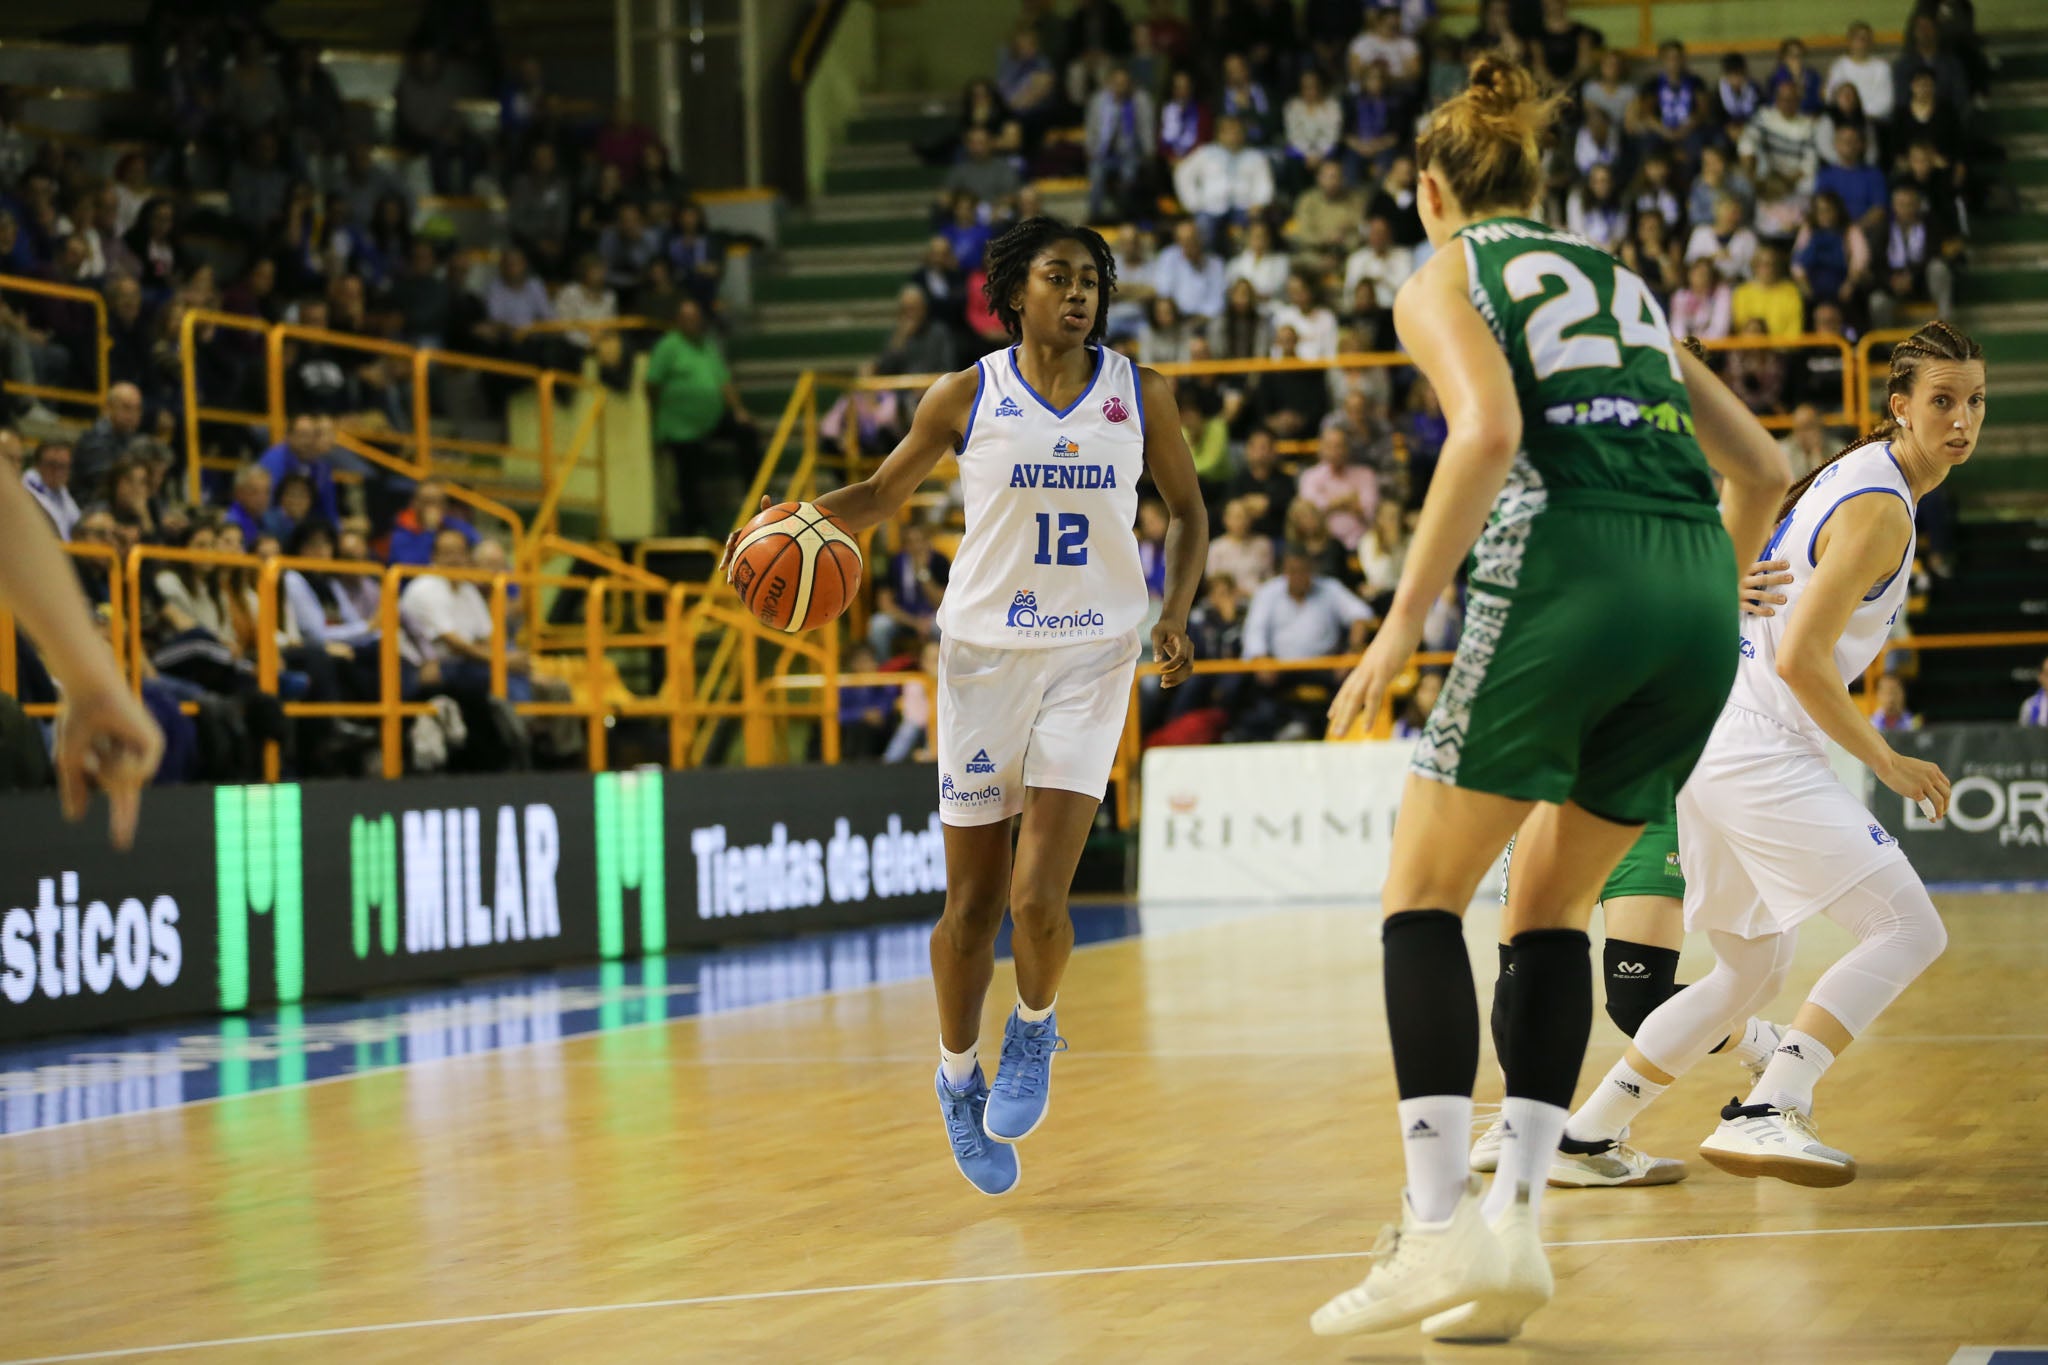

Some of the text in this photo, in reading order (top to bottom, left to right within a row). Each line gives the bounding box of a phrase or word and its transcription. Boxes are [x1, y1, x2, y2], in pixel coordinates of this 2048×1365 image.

[1503, 251, 1684, 382] 24
[995, 408, 1024, 417] PEAK
[1010, 463, 1117, 489] AVENIDA
[1034, 513, 1090, 566] 12
[966, 763, 996, 773] PEAK
[1165, 806, 1400, 850] RIMM
[402, 802, 562, 955] MILAR
[690, 820, 826, 920] Tiendas
[826, 815, 870, 904] de
